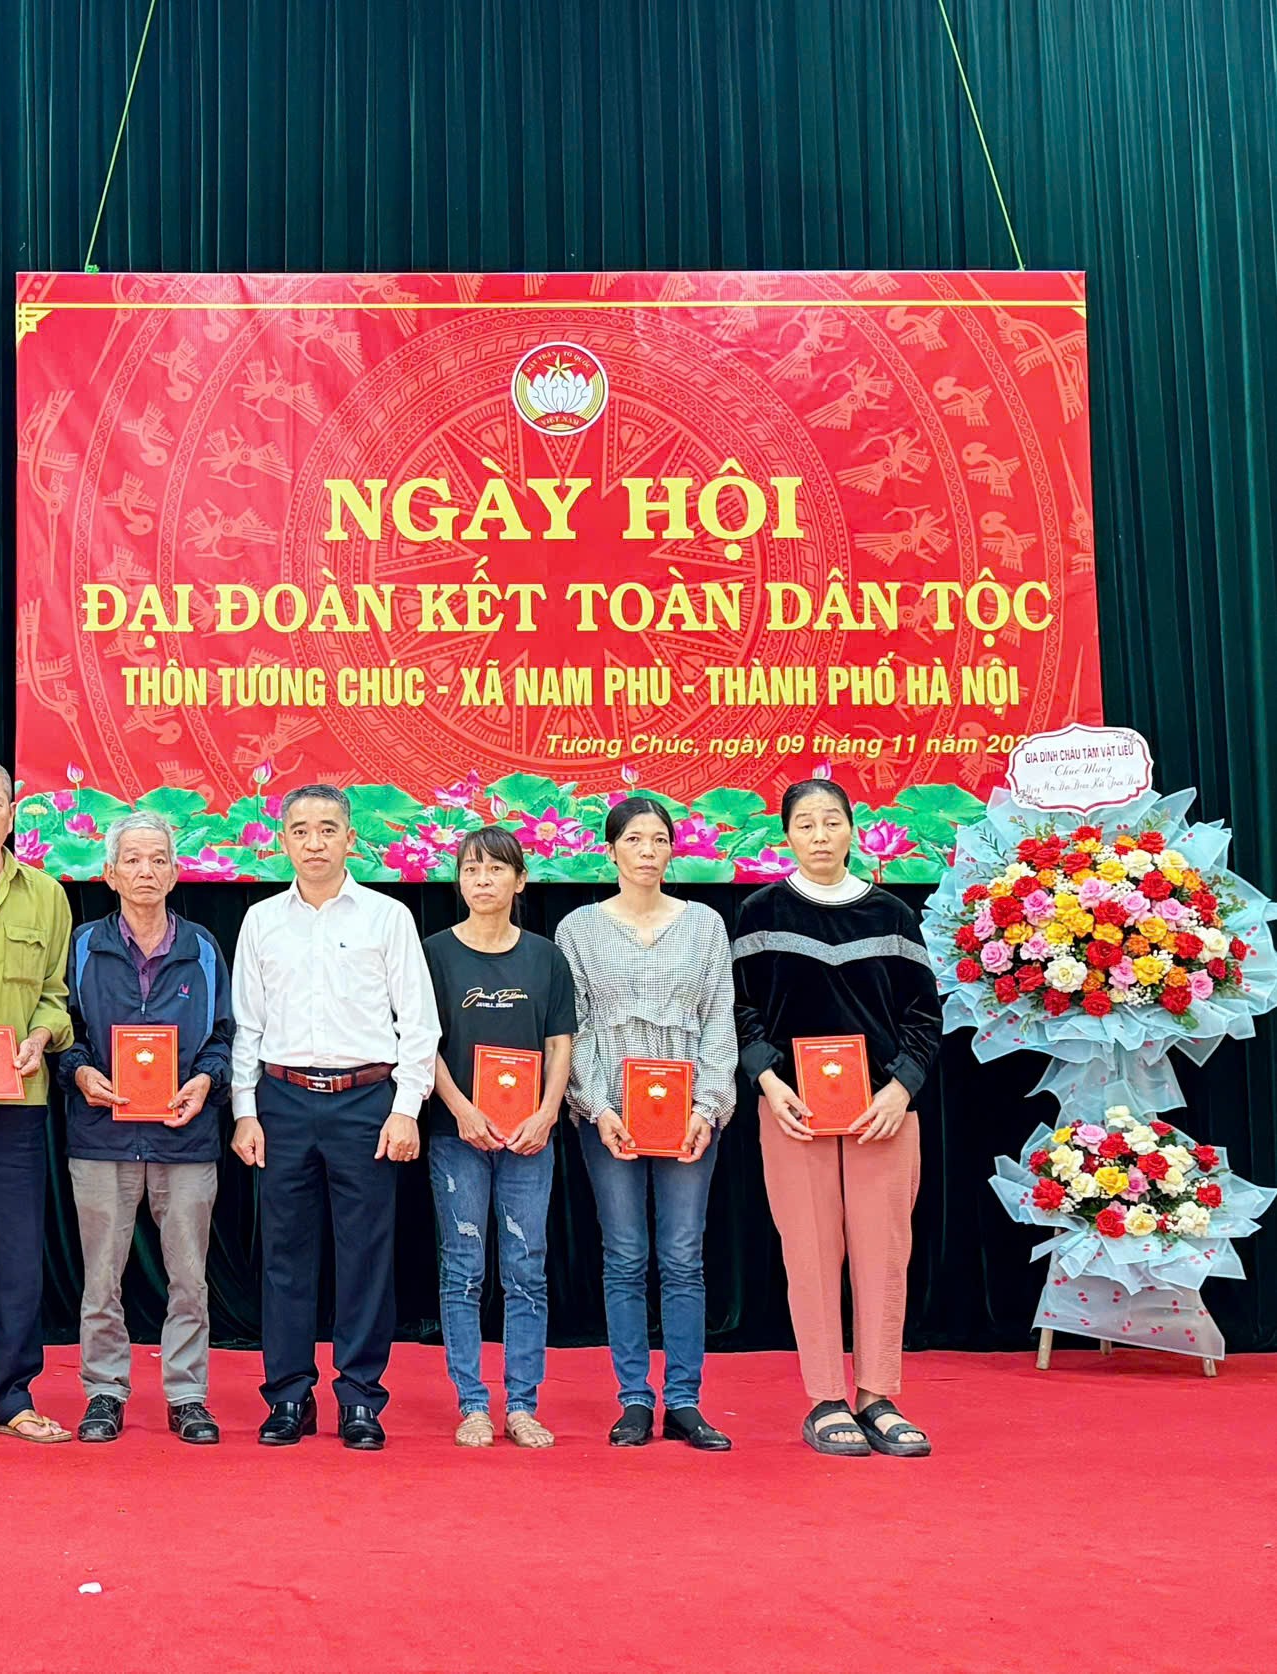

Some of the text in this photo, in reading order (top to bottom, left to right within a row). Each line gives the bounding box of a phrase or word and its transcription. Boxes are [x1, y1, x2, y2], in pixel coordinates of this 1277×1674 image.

[324, 457, 805, 560] NGÀY HỘI
[82, 556, 1053, 648] ĐẠI ĐOÀN KẾT TOÀN DÂN TỘC
[122, 652, 1020, 715] THÔN TƯƠNG CHÚC - XÃ NAM PHÙ - THÀNH PHỐ HÀ NỘI
[546, 734, 623, 759] Tương
[630, 733, 701, 758] Chúc,
[708, 735, 769, 759] ngày
[776, 734, 805, 754] 09
[812, 733, 883, 759] tháng
[891, 734, 917, 754] 11
[926, 733, 978, 754] năm
